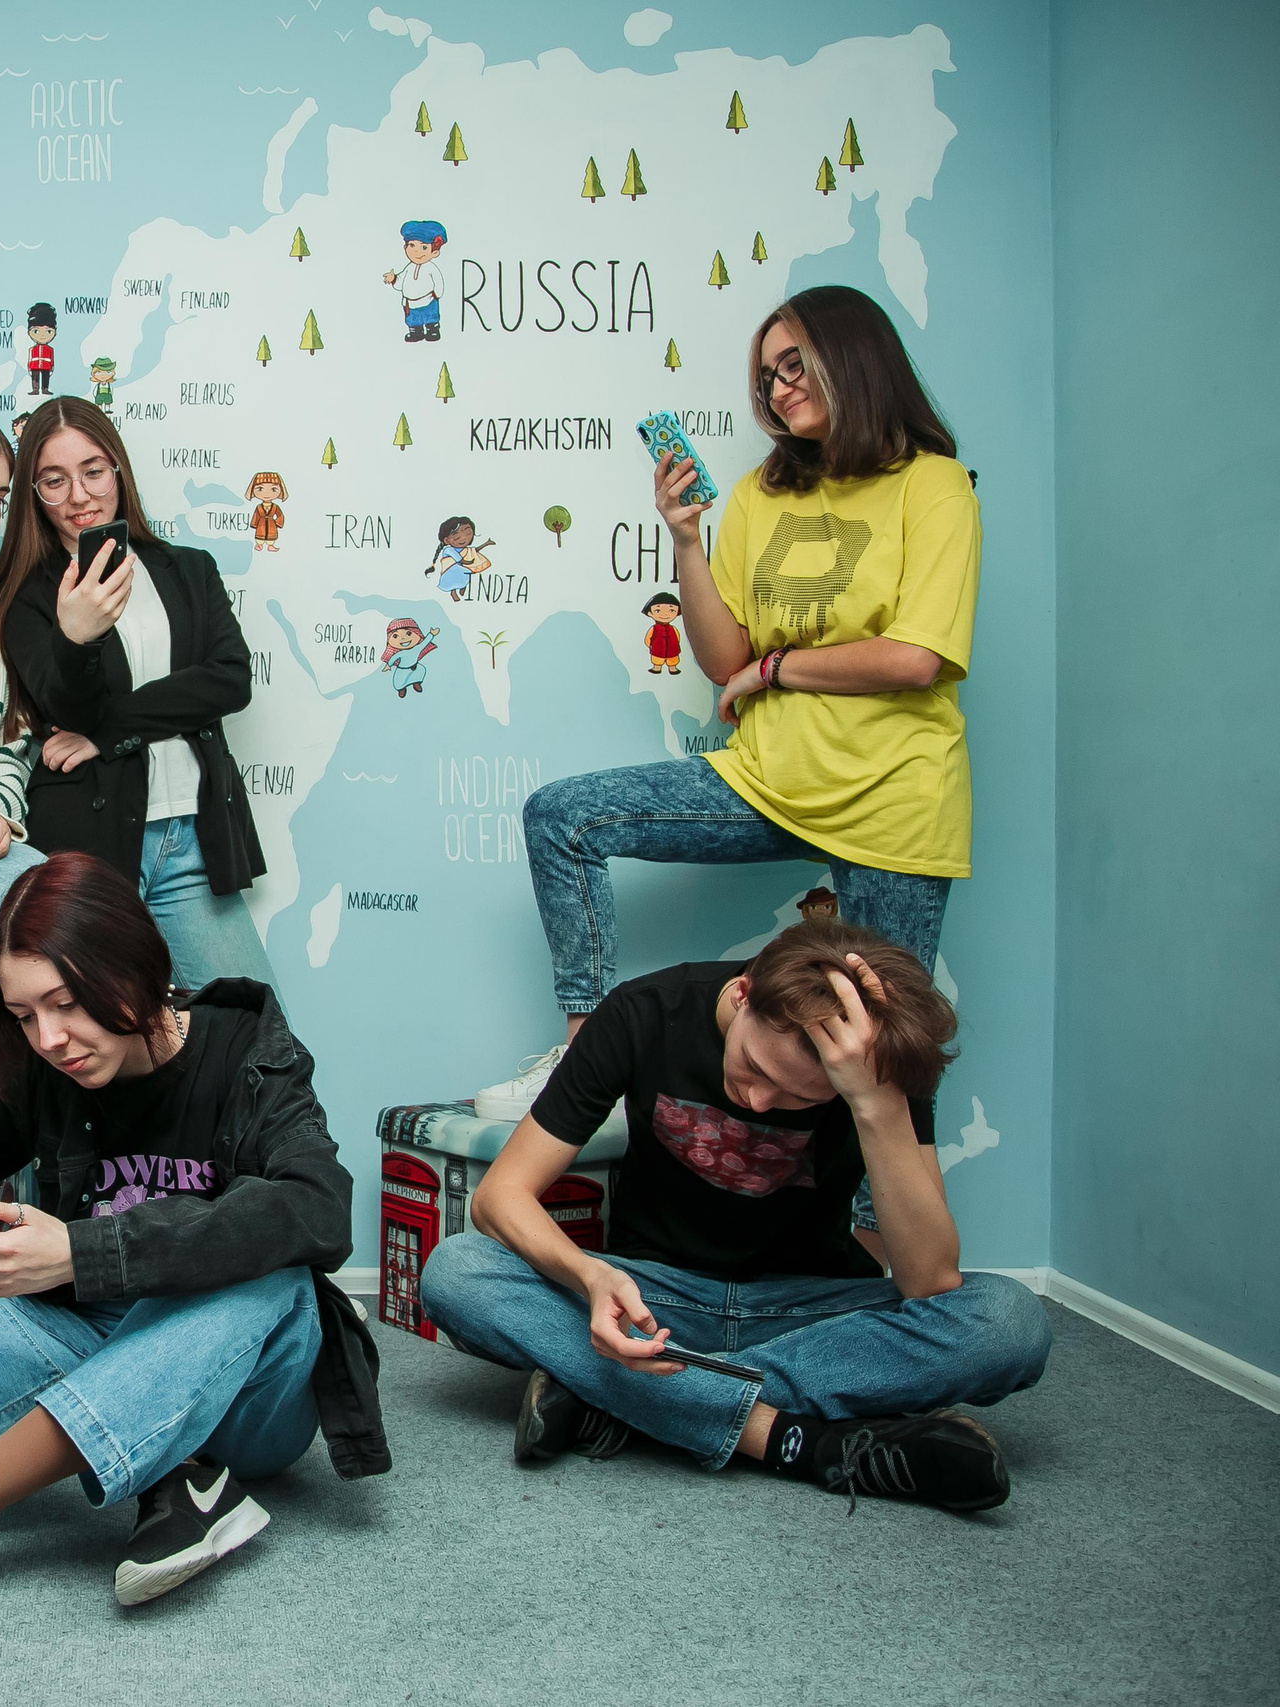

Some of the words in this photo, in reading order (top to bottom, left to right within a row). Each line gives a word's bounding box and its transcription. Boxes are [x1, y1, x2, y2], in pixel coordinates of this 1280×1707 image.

[32, 79, 123, 128] ARCTIC
[39, 134, 111, 183] OCEAN
[124, 280, 162, 296] SWEDEN
[461, 259, 653, 333] RUSSIA
[65, 297, 108, 314] NORWAY
[181, 291, 229, 309] FINLAND
[181, 383, 235, 405] BELARUS
[126, 403, 167, 420] POLAND
[471, 417, 611, 451] KAZAKHSTAN
[649, 410, 733, 437] NGOLIA
[162, 448, 220, 468] UKRAINE
[147, 520, 176, 538] REECE
[207, 512, 249, 531] TURKEY
[325, 514, 391, 548] IRAN
[464, 572, 528, 604] INDIA
[315, 623, 352, 643] SAUDI
[335, 646, 375, 663] ARABIA
[240, 764, 294, 796] KENYA
[439, 756, 540, 808] INDIAN
[348, 892, 418, 912] MADAGASCAR
